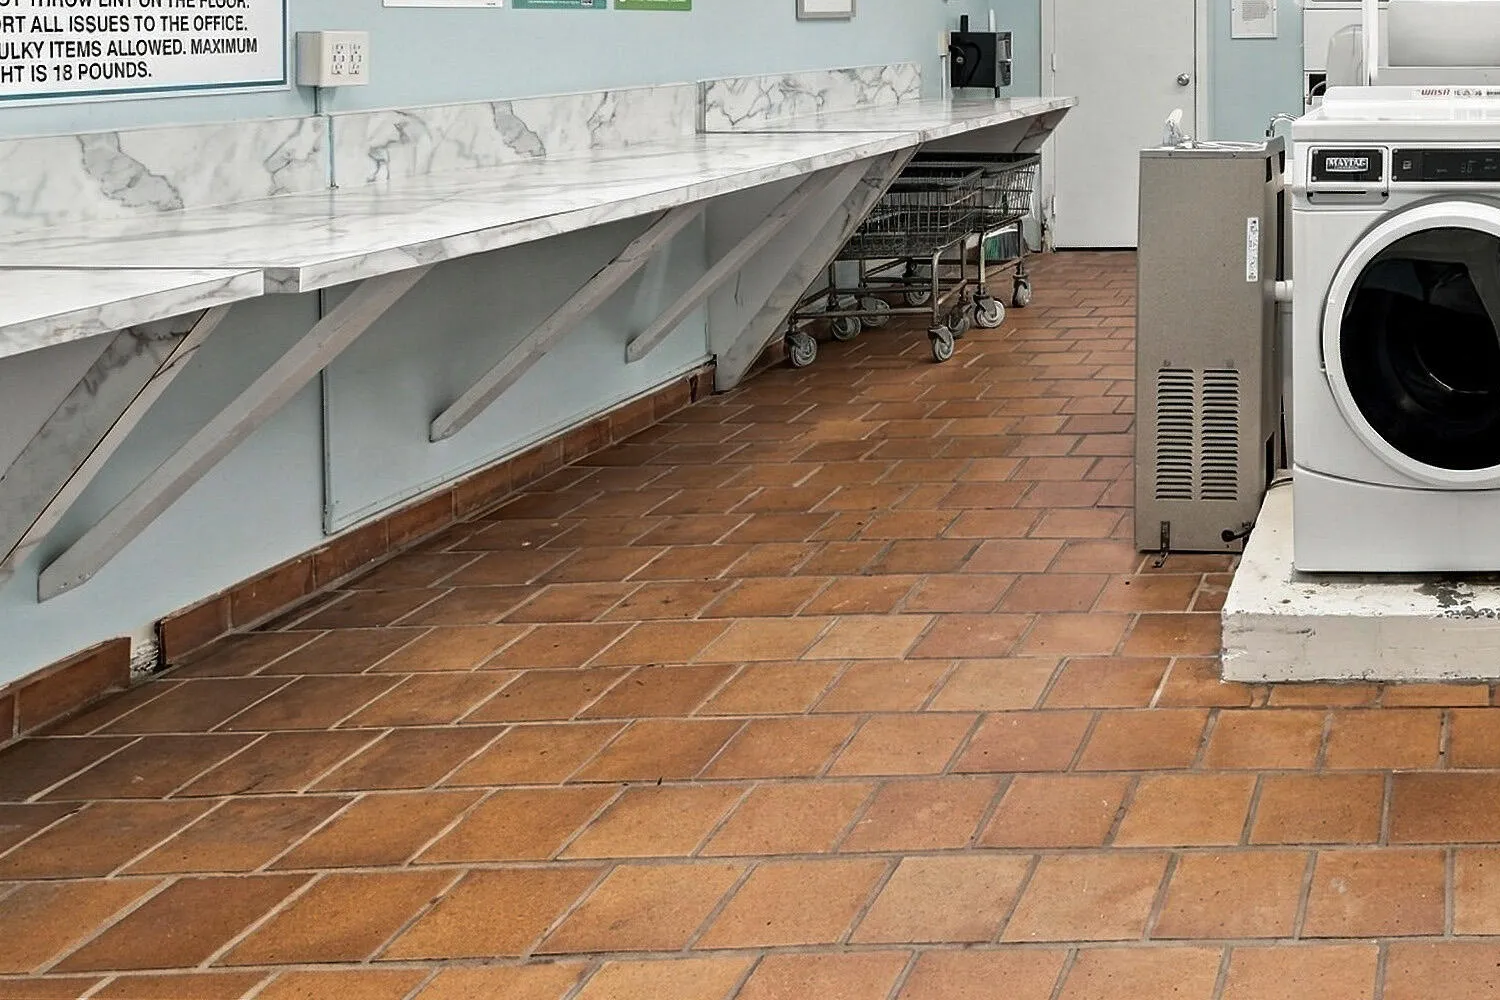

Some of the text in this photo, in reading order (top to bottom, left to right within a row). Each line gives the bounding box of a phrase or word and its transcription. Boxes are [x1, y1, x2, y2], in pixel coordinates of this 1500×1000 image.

[0, 15, 248, 33] RT ALL ISSUES TO THE OFFICE.
[0, 37, 258, 59] ULKY ITEMS ALLOWED. MAXIMUM
[1, 61, 152, 83] HT IS 18 POUNDS.
[1328, 159, 1367, 167] MAYTAG
